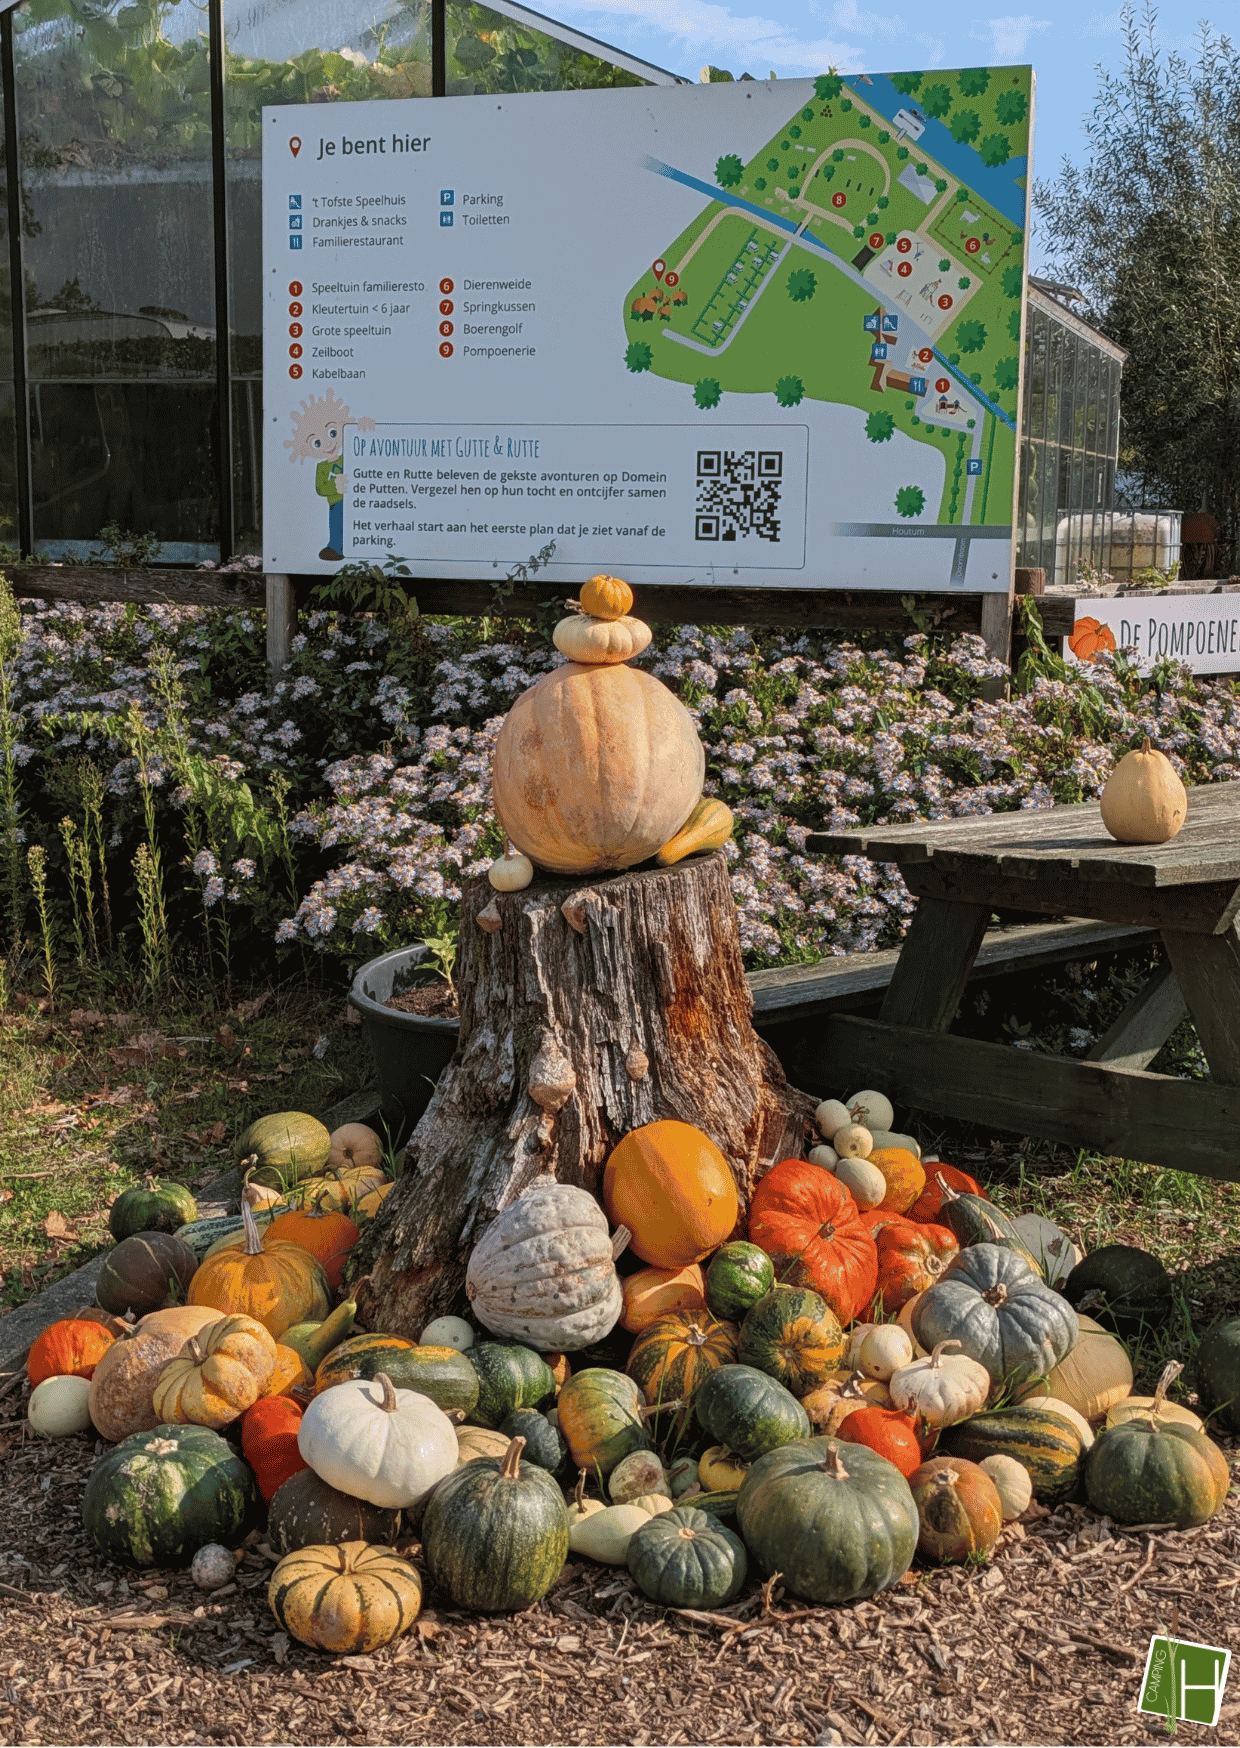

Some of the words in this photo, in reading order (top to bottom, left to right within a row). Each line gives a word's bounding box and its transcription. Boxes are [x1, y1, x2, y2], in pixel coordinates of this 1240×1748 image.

[317, 137, 336, 161] Je
[342, 135, 386, 156] bent
[392, 133, 431, 153] hier
[321, 196, 353, 208] Tofste
[356, 195, 406, 209] Speelhuis
[463, 193, 504, 208] Parking
[313, 216, 358, 230] Drankjes
[361, 216, 369, 226] &
[372, 214, 407, 226] snacks
[462, 213, 510, 226] Toiletten
[313, 236, 404, 248] Familierestaurant
[312, 282, 360, 296] Speeltuin
[363, 281, 424, 292] familieresto
[464, 278, 532, 292] Dierenweide
[312, 304, 368, 314] Kleutertuin
[389, 303, 410, 316] jaar
[464, 300, 536, 314] Springkussen
[312, 326, 341, 336] Grote
[344, 325, 392, 338] speeltuin
[464, 322, 523, 337] Boerengolf
[312, 347, 354, 358] Zeilboot
[464, 345, 536, 359] Pompoenerie
[312, 368, 366, 378] Kabelbaan
[494, 435, 503, 455] &
[353, 468, 383, 479] Gutte
[387, 471, 399, 479] en
[403, 469, 433, 479] Rutte
[437, 470, 479, 480] beleven
[483, 470, 496, 480] de
[500, 471, 537, 483] gekste
[541, 472, 599, 481] avonturen
[603, 474, 617, 484] op
[622, 472, 667, 482] Domein
[353, 483, 366, 493] de
[369, 483, 408, 494] Putten.
[411, 484, 457, 497] Vergezel
[460, 485, 481, 495] hen
[485, 487, 498, 498] op
[502, 485, 523, 496] hun
[527, 486, 556, 496] tocht
[560, 488, 573, 496] en
[577, 487, 624, 500] ontcijfer
[628, 489, 666, 497] samen
[353, 498, 366, 508] de
[369, 499, 417, 509] raadsels.
[353, 520, 371, 530] Het
[375, 521, 414, 531] verhaal
[418, 523, 443, 532] start
[446, 525, 466, 533] aan
[470, 523, 488, 533] het
[492, 524, 526, 534] eerste
[530, 524, 554, 537] plan
[557, 524, 576, 535] dat
[578, 525, 589, 537] je
[592, 525, 613, 536] ziet
[616, 526, 649, 536] vanaf
[651, 527, 666, 536] de
[893, 527, 925, 536] Houtum
[352, 535, 396, 548] parking.
